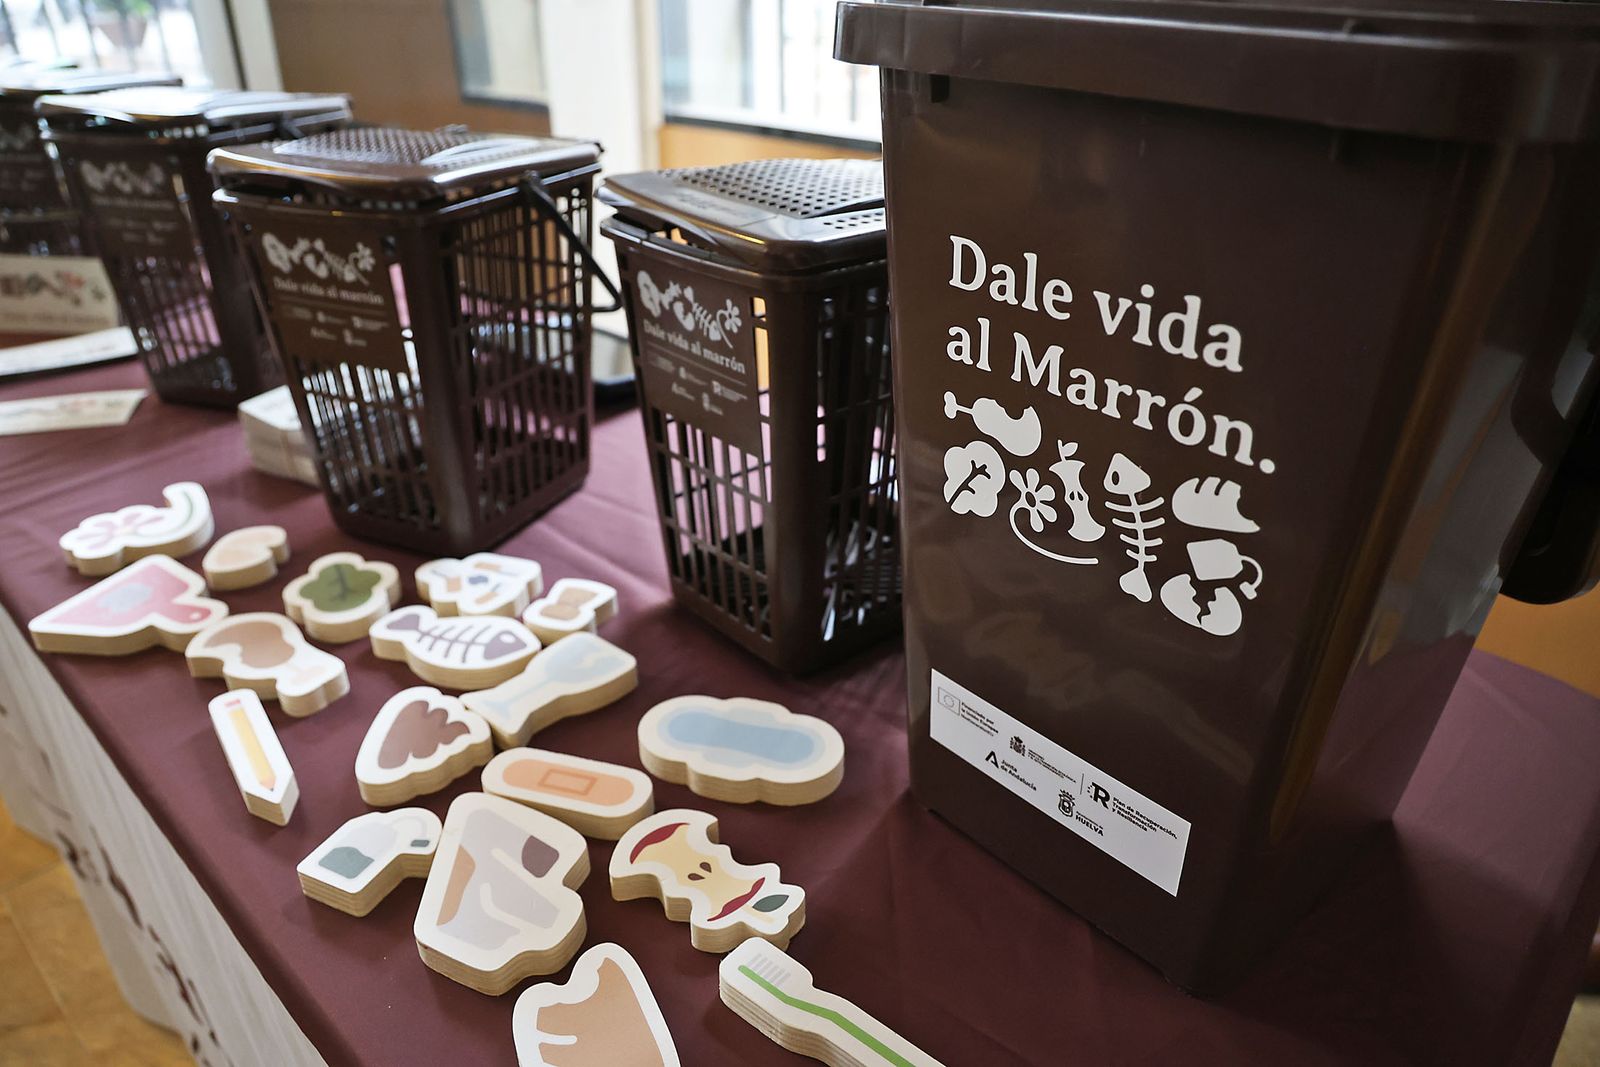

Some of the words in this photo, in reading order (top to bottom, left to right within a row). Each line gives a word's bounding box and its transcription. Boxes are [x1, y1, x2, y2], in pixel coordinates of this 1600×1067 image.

[949, 234, 1073, 320] Dale
[1092, 283, 1243, 373] vida
[667, 332, 690, 354] vida
[691, 341, 702, 356] al
[703, 348, 746, 374] marrón
[946, 317, 992, 372] al
[1010, 331, 1276, 475] Marrón.
[1001, 759, 1017, 773] Junta
[1008, 769, 1037, 791] Andalucía
[1075, 814, 1104, 837] HUELVA
[1112, 801, 1157, 832] Transformación
[1113, 797, 1126, 808] Plan
[1126, 805, 1134, 813] de
[1135, 810, 1178, 840] Recuperación,
[1117, 810, 1148, 832] Resiliencia
